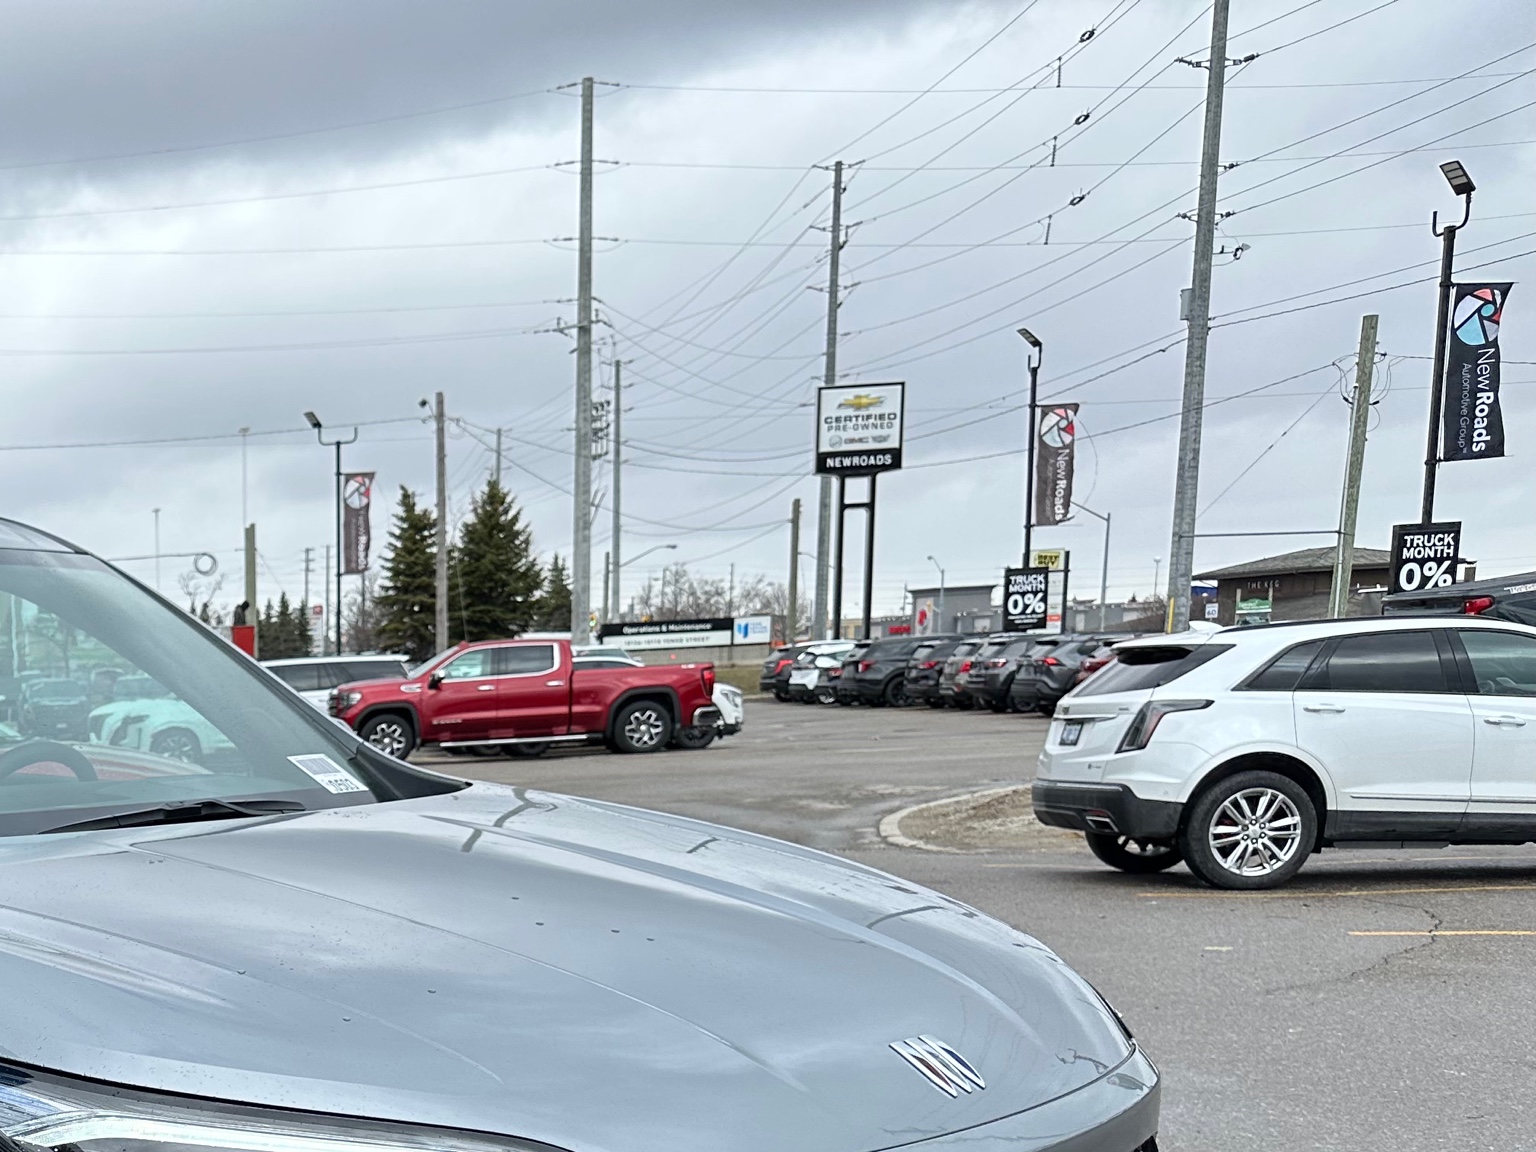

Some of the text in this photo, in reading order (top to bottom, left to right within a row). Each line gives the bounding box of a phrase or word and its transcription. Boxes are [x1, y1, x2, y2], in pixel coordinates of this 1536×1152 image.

[1460, 363, 1472, 415] Automotive
[1472, 348, 1497, 452] NewRoads
[824, 412, 897, 425] CERTIFIED
[827, 422, 893, 432] PRE-OWNED
[826, 454, 892, 468] NEWROADS
[1055, 449, 1070, 520] NewRoads
[1404, 533, 1455, 547] TRUCK
[1402, 546, 1454, 559] MONTH
[1009, 574, 1045, 585] TRUCK
[1399, 560, 1453, 591] 0%
[1009, 584, 1045, 593] MONTH
[1247, 580, 1280, 589] THE KEG
[1007, 592, 1045, 615] 0%
[623, 626, 662, 635] Operations
[668, 622, 712, 631] Maintenance
